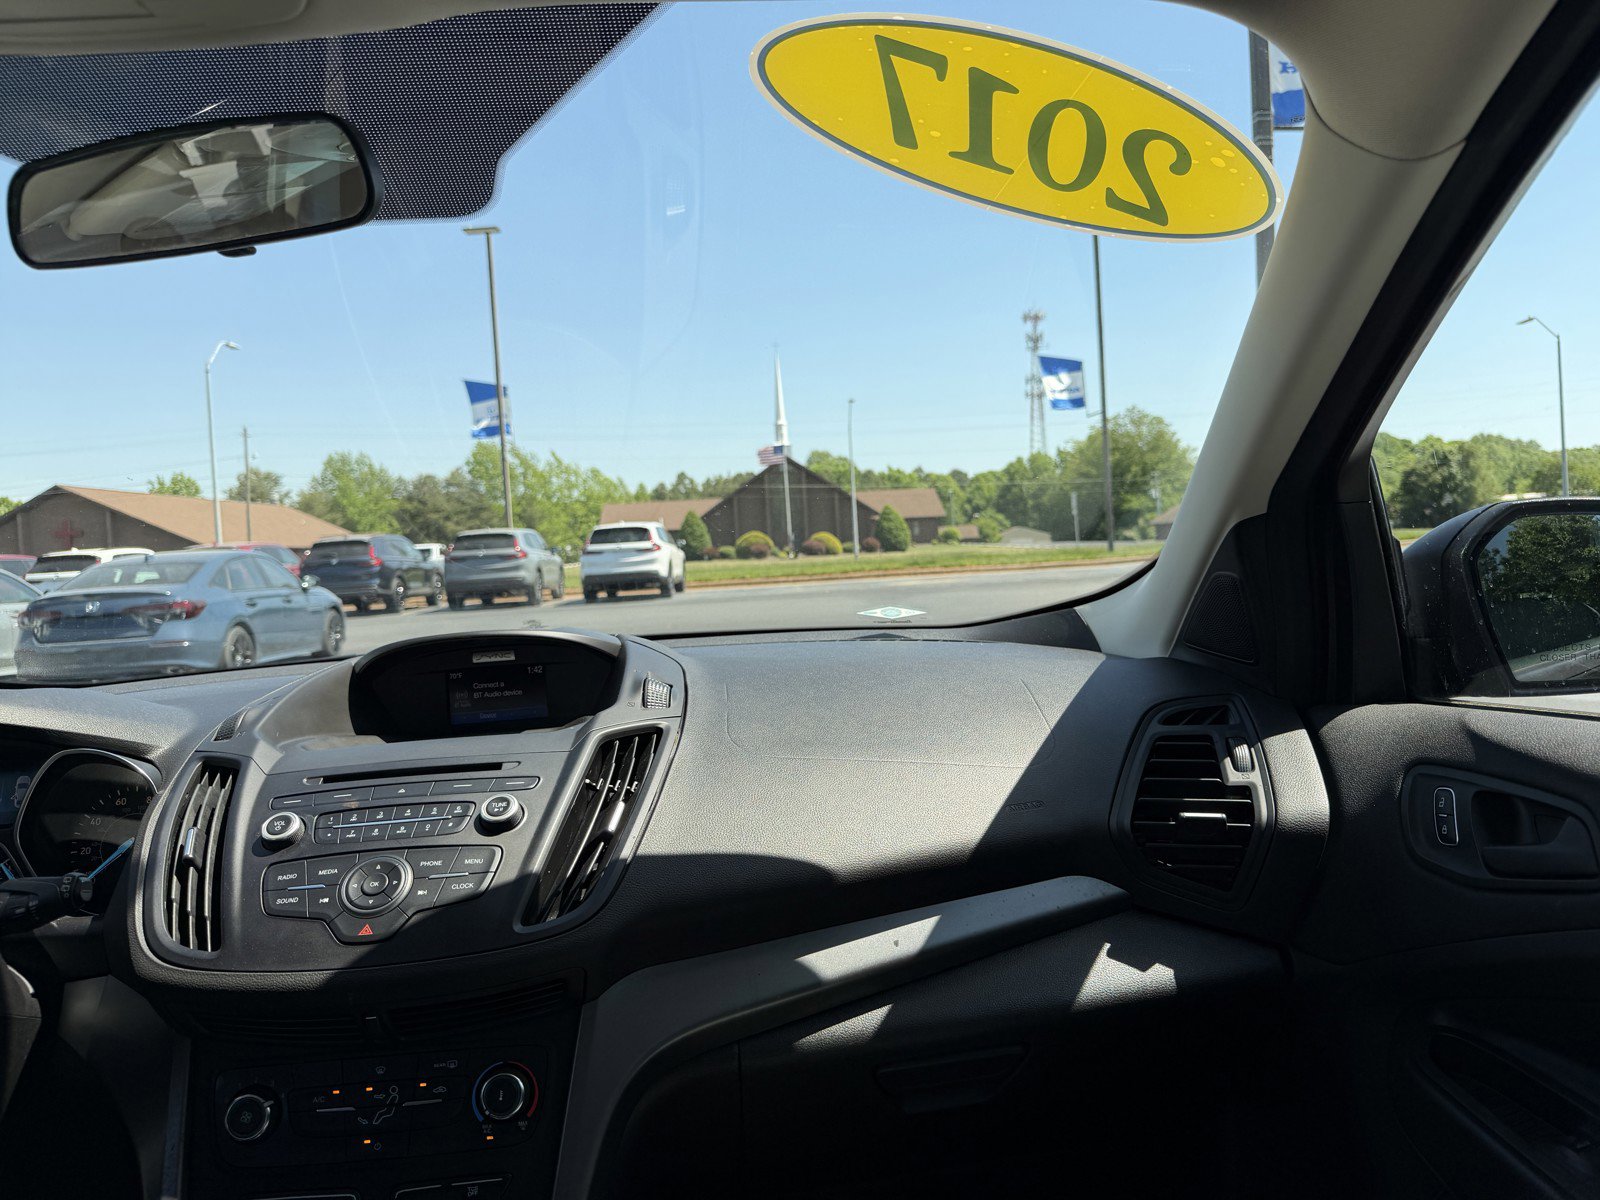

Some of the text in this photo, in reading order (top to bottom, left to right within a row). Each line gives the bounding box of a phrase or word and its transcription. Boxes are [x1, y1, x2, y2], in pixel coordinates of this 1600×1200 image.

[527, 665, 543, 674] 1:42
[115, 797, 127, 806] 60
[90, 818, 101, 826] 40
[80, 847, 91, 856] 20
[277, 873, 298, 881] RADIO
[451, 882, 474, 890] CLOCK
[275, 896, 299, 905] SOUND
